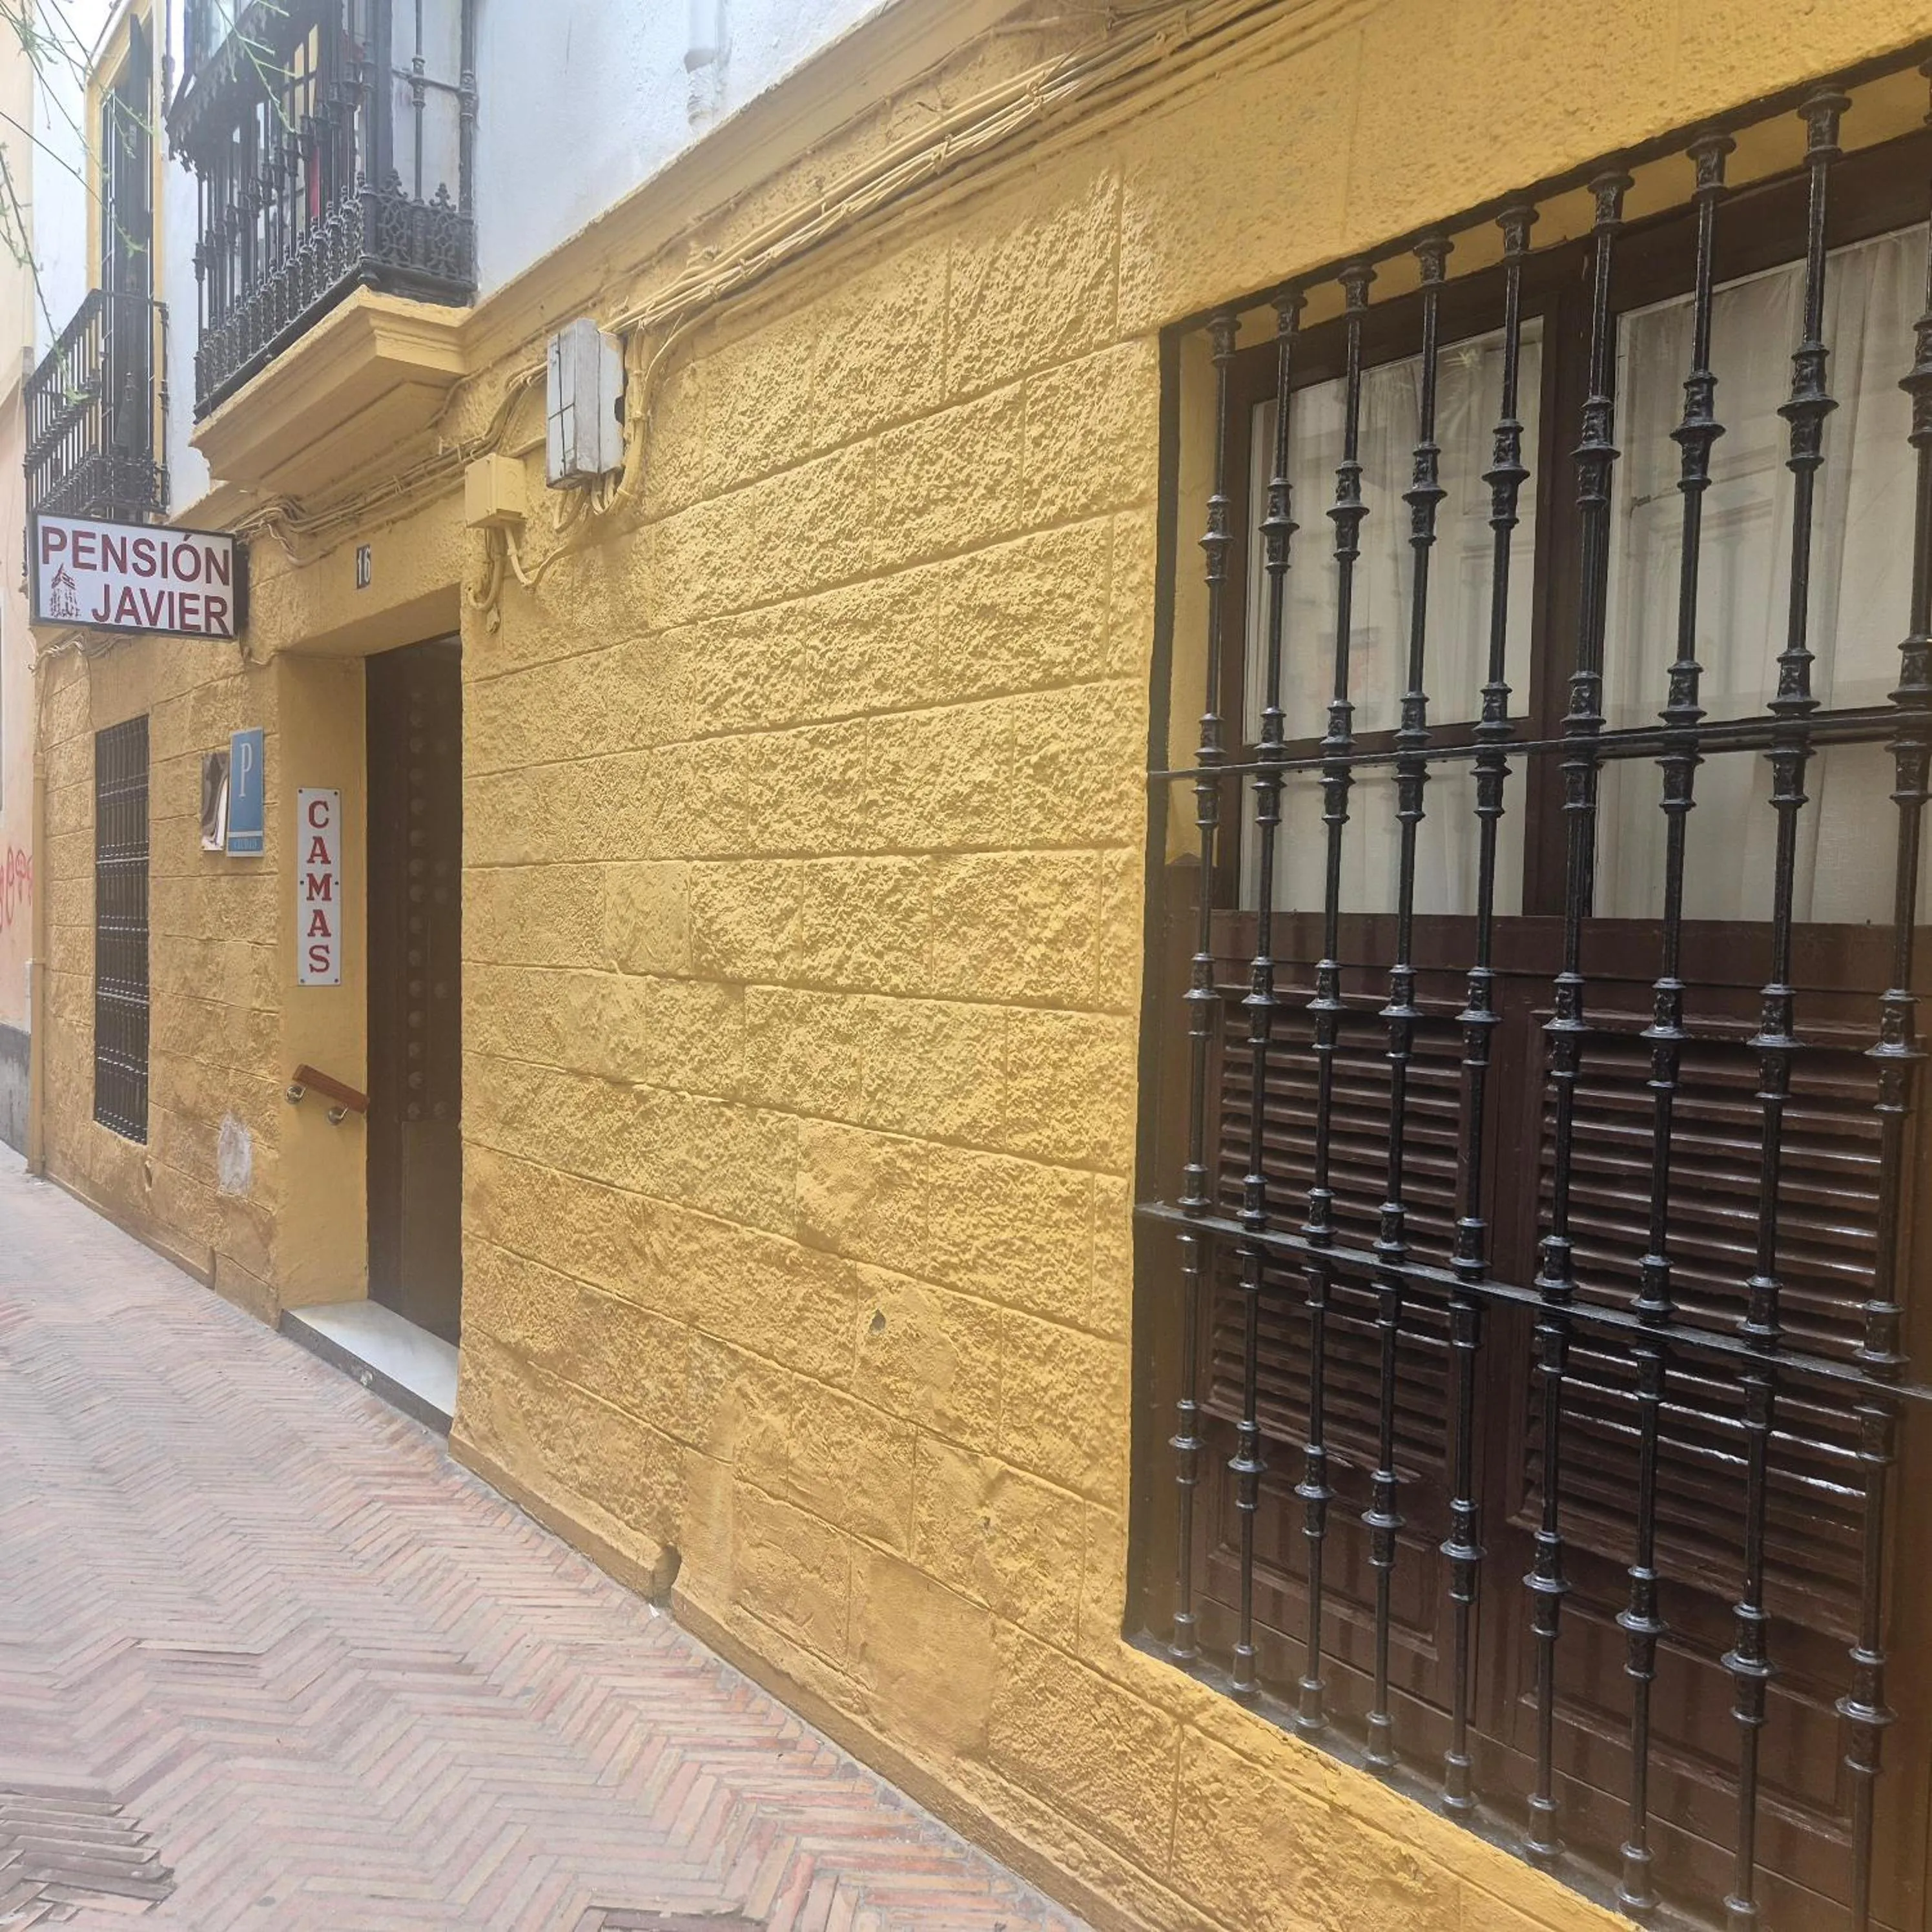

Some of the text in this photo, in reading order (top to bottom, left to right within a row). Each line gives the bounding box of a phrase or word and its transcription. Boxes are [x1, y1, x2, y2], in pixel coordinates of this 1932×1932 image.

[41, 525, 230, 586] PENSIÓN
[91, 583, 231, 636] JAVIER
[238, 742, 252, 799] P
[306, 800, 332, 973] CAMAS
